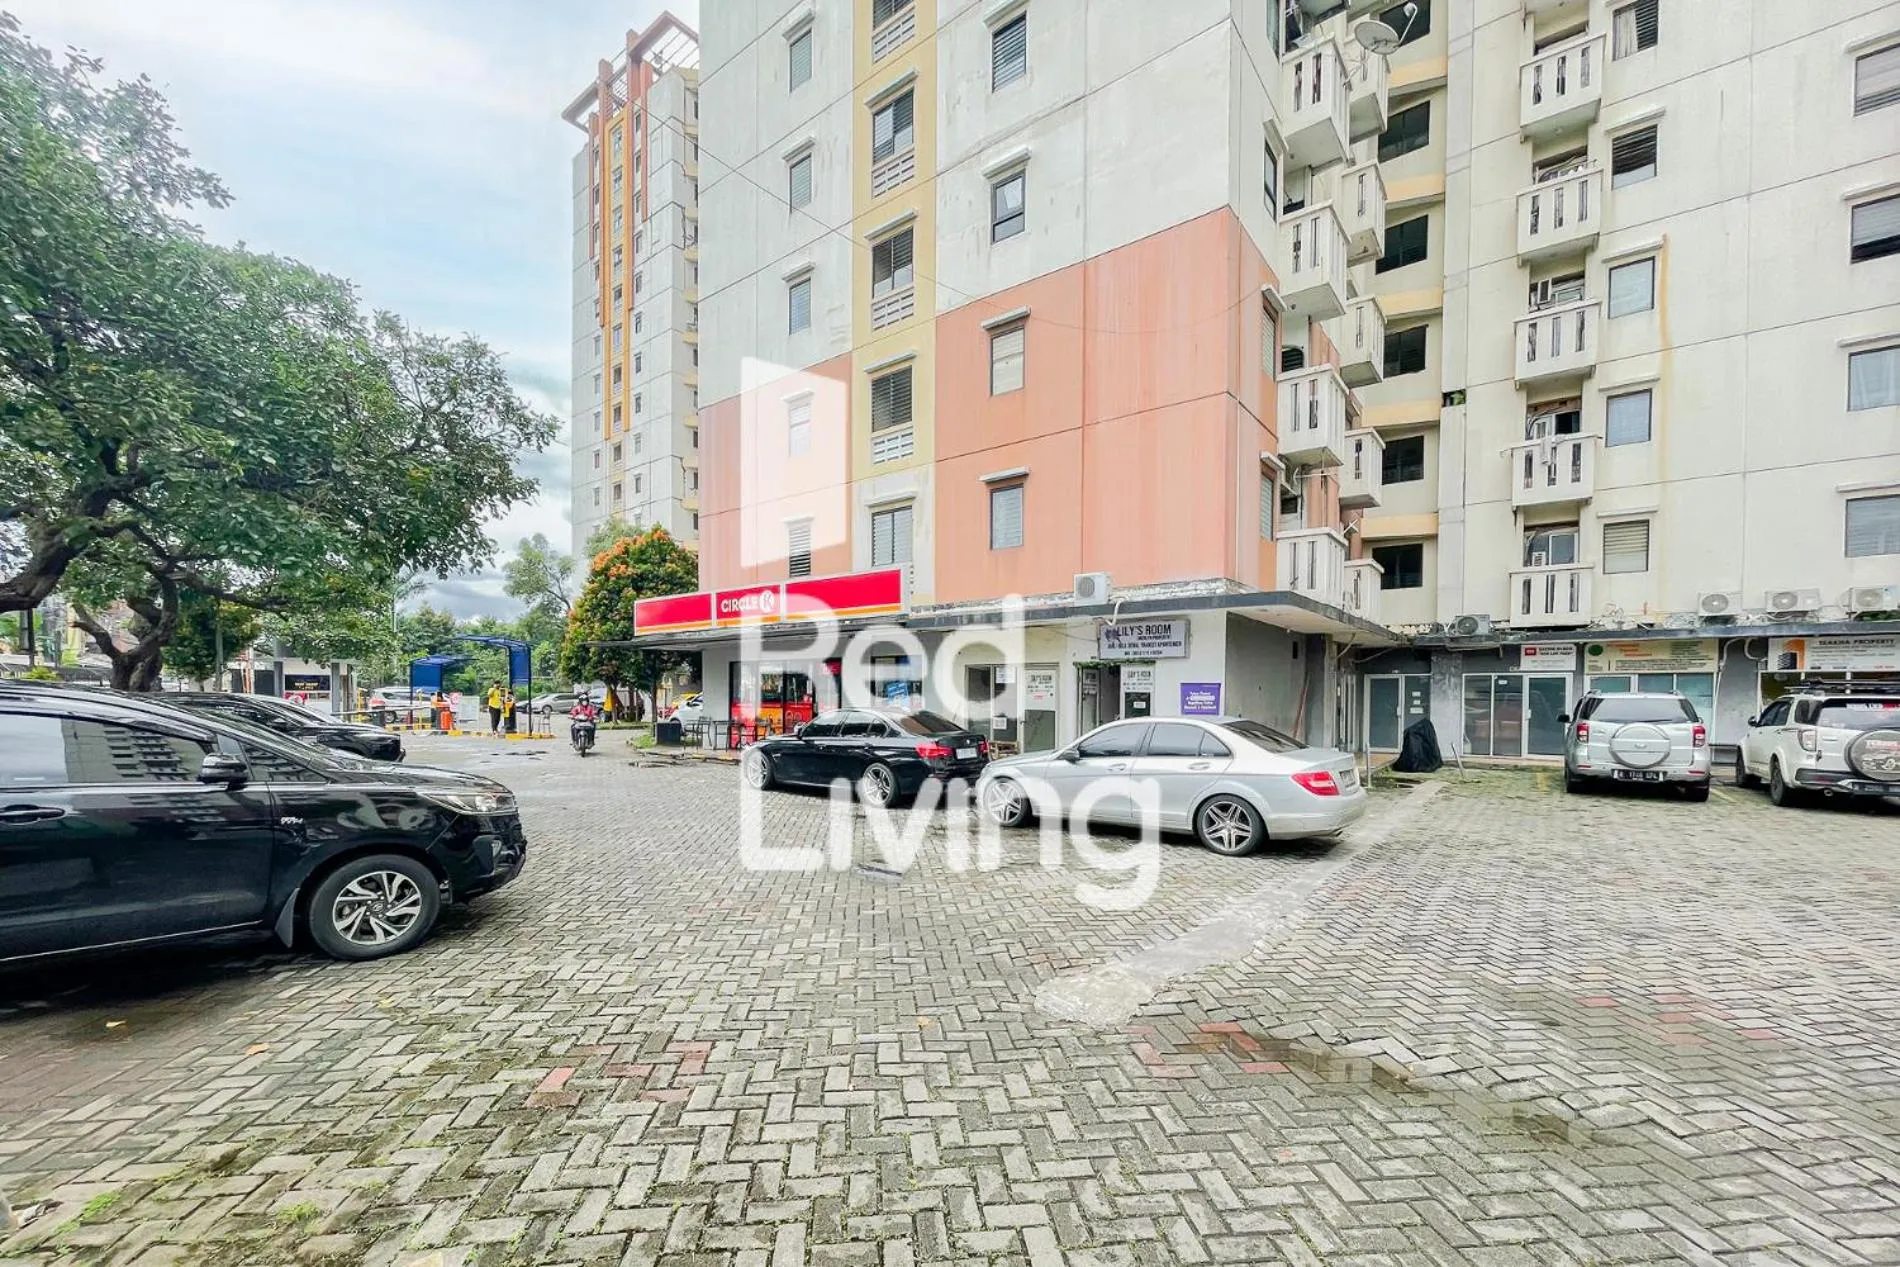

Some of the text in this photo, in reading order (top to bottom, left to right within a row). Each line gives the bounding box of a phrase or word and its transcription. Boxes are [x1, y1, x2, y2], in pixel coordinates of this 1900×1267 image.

[721, 596, 758, 613] CIRCLE
[1116, 624, 1171, 637] LILY'S ROOM
